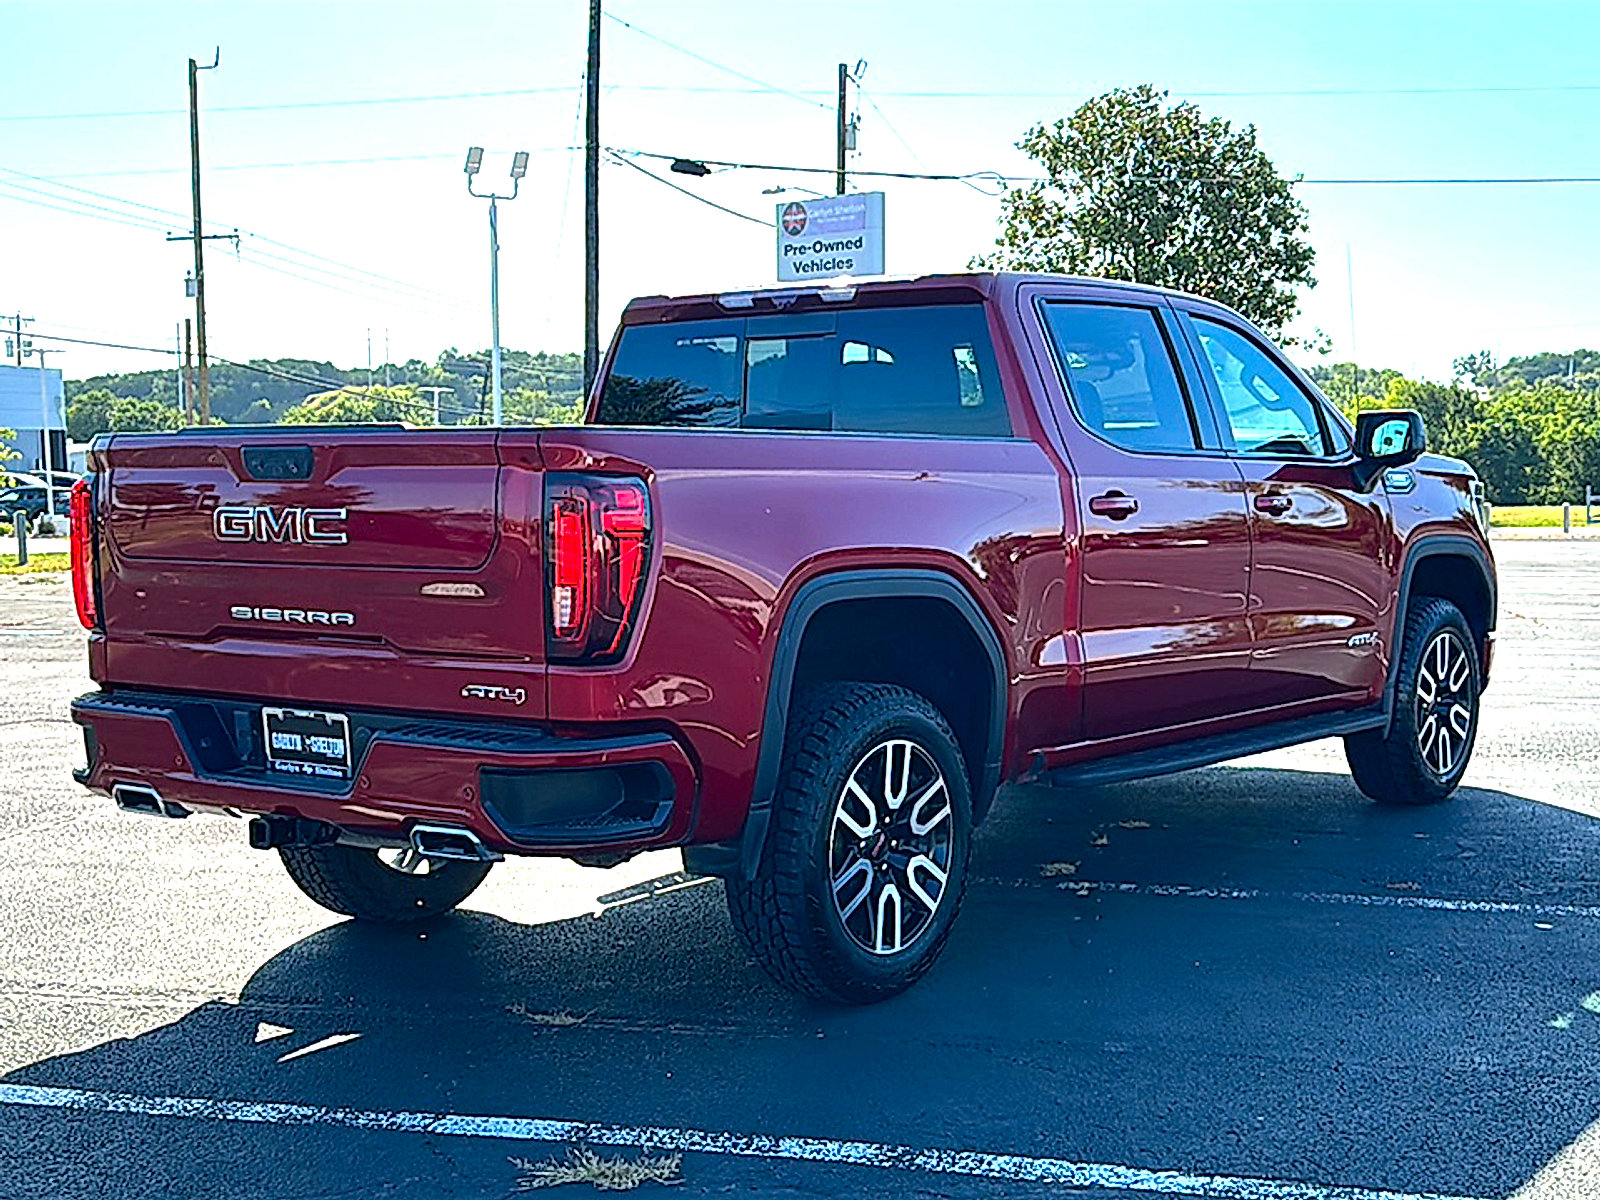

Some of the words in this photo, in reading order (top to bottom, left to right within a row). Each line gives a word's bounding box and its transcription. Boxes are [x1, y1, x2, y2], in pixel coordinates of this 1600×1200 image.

[784, 236, 863, 257] Pre-Owned
[793, 258, 854, 274] Vehicles
[213, 506, 348, 544] GMC
[230, 606, 355, 625] SIERRA
[461, 684, 526, 705] AT4
